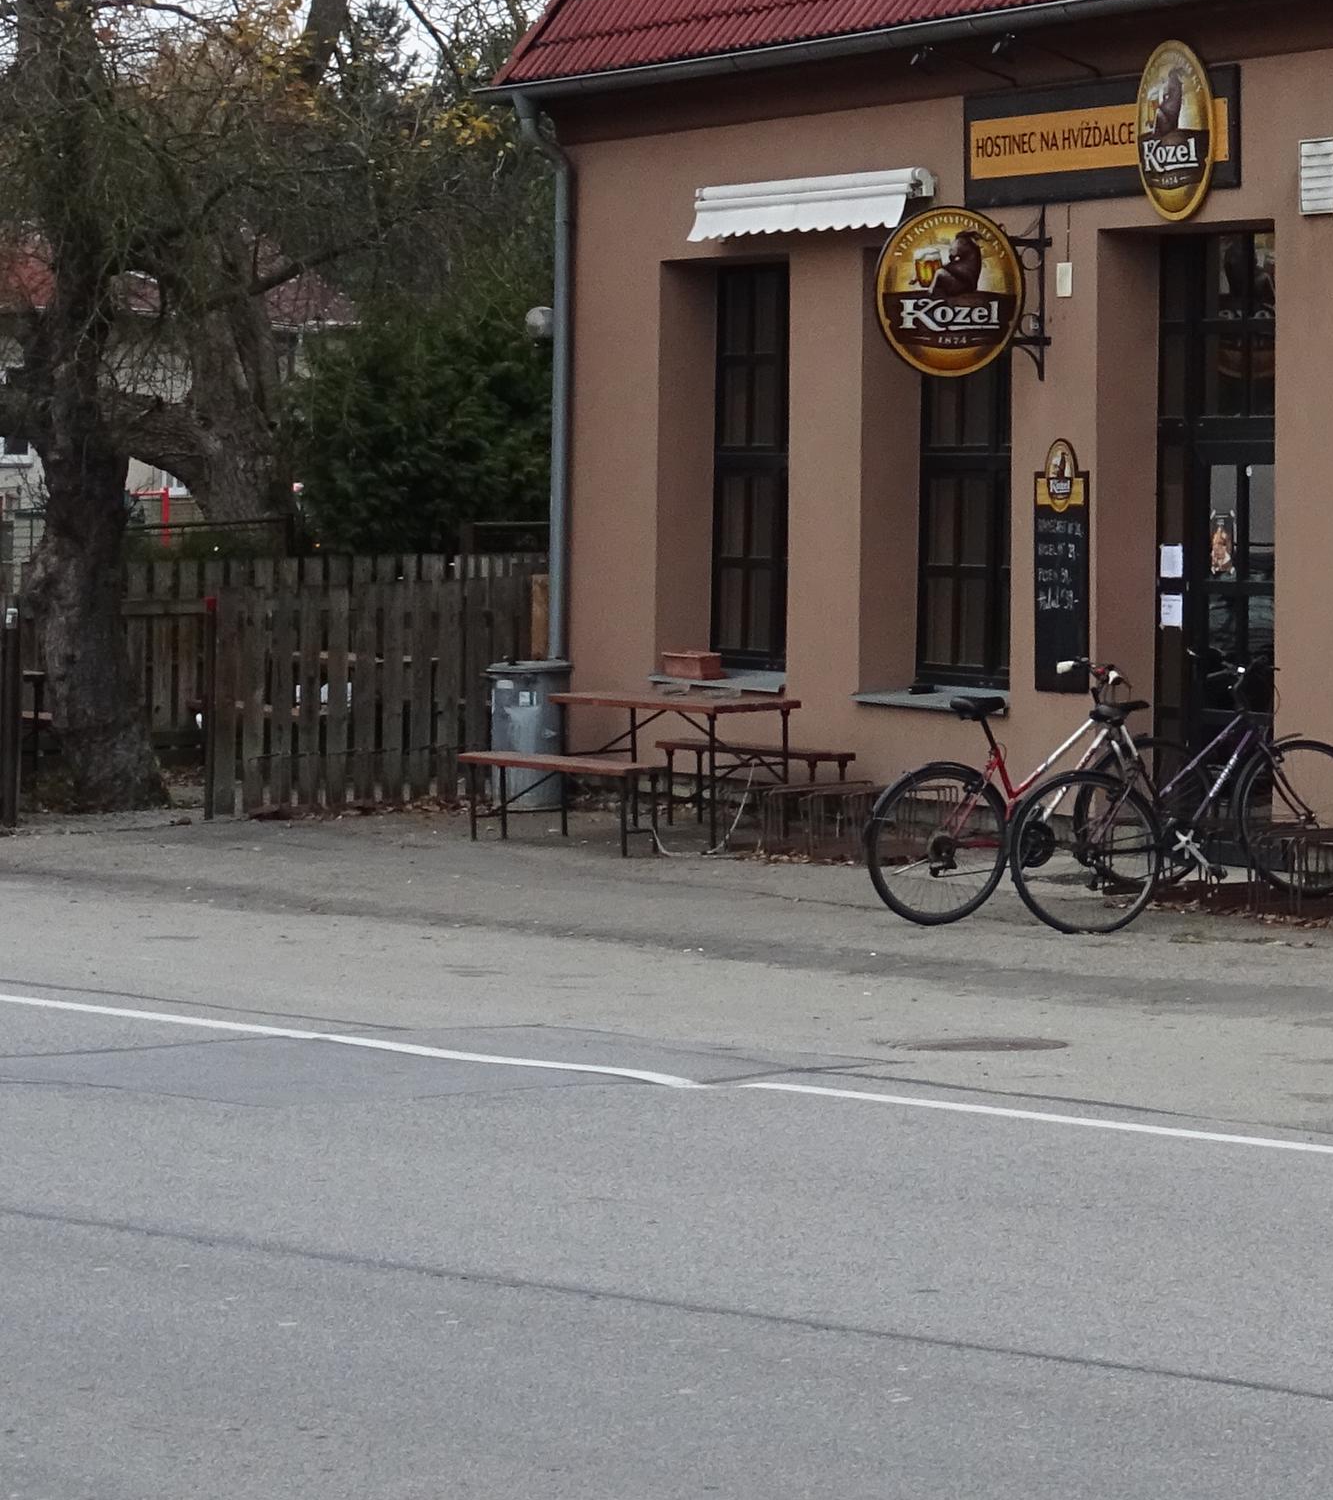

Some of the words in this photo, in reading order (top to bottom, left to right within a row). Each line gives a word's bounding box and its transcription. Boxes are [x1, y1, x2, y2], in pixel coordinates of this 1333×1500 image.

[976, 132, 1037, 158] HOSTINEC
[1040, 129, 1059, 151] NA
[1062, 120, 1135, 150] HVÍŽĎALCE
[1143, 137, 1199, 172] Kozel
[899, 299, 1000, 332] Kozel
[938, 335, 967, 345] 1874
